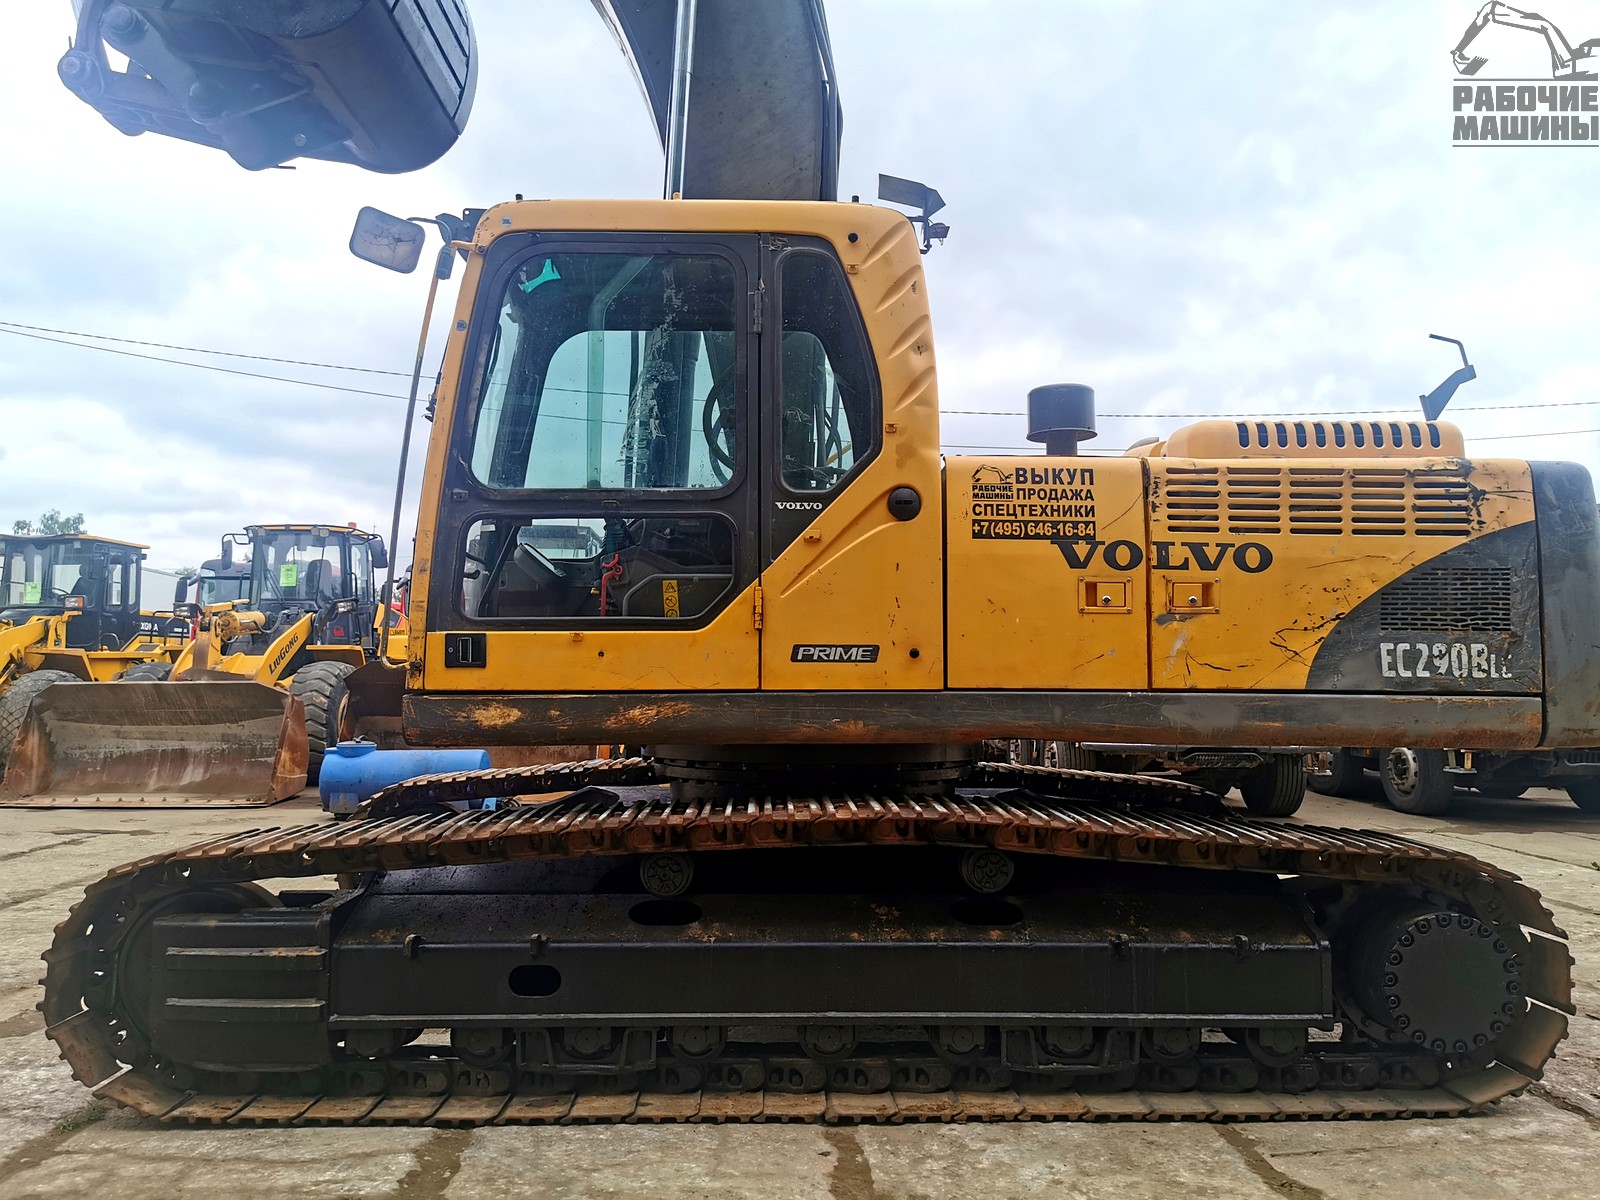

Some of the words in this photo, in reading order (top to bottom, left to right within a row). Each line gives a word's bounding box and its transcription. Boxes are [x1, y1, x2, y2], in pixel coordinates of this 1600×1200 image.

[1015, 467, 1094, 485] ВЫКУП
[1016, 488, 1094, 503] ПРОДАЖА
[775, 501, 823, 510] VOLVO
[972, 504, 1095, 519] СПЕЦТЕХНИКИ
[1050, 540, 1273, 573] VOLVO
[796, 646, 873, 661] PRIME
